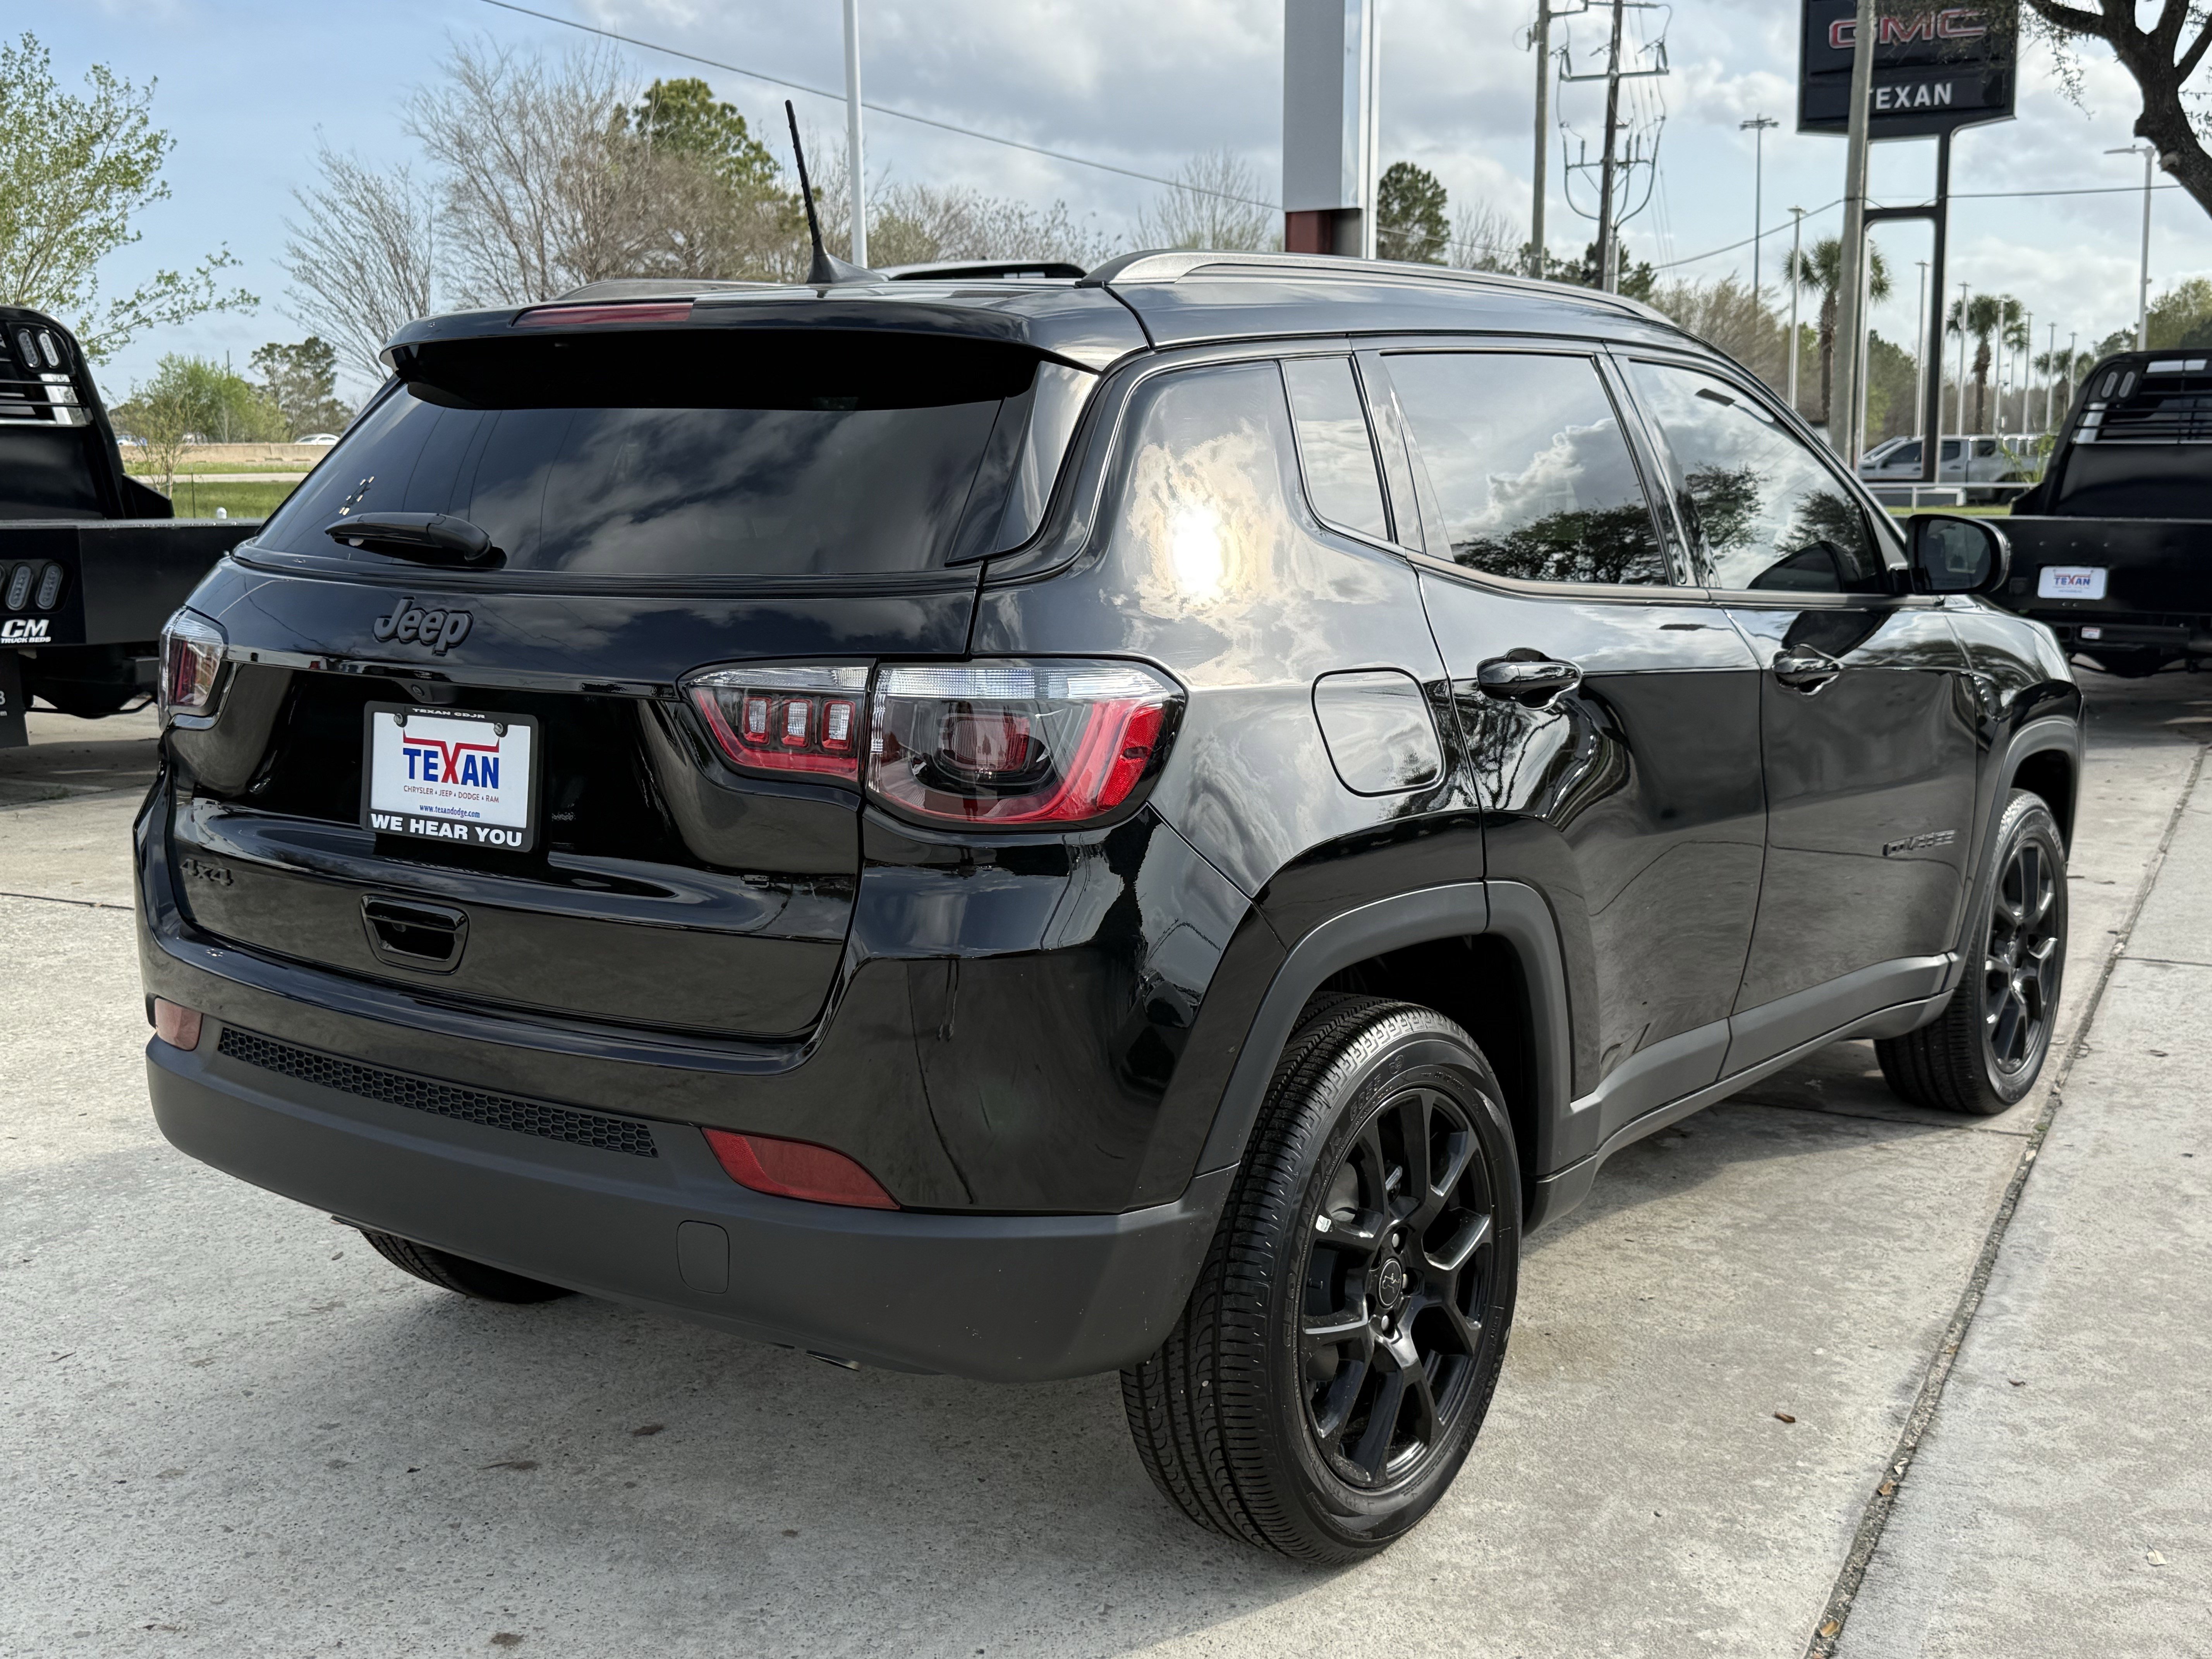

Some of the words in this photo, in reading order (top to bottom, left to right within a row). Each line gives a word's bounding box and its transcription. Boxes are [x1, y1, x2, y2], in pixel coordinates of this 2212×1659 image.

[1869, 82, 1952, 110] EXAN
[2054, 572, 2091, 586] TEXAN
[1, 619, 50, 637] CM
[373, 596, 473, 656] Jeep
[412, 708, 451, 716] TEXAN
[402, 729, 500, 789] TEXAN
[404, 785, 434, 795] CHRYSLER
[458, 792, 480, 801] DODGE
[486, 795, 500, 803] RAM
[419, 805, 480, 818] www.texandodge.com
[371, 814, 403, 831] WE
[409, 819, 468, 840] HEAR
[475, 827, 522, 847] YOU
